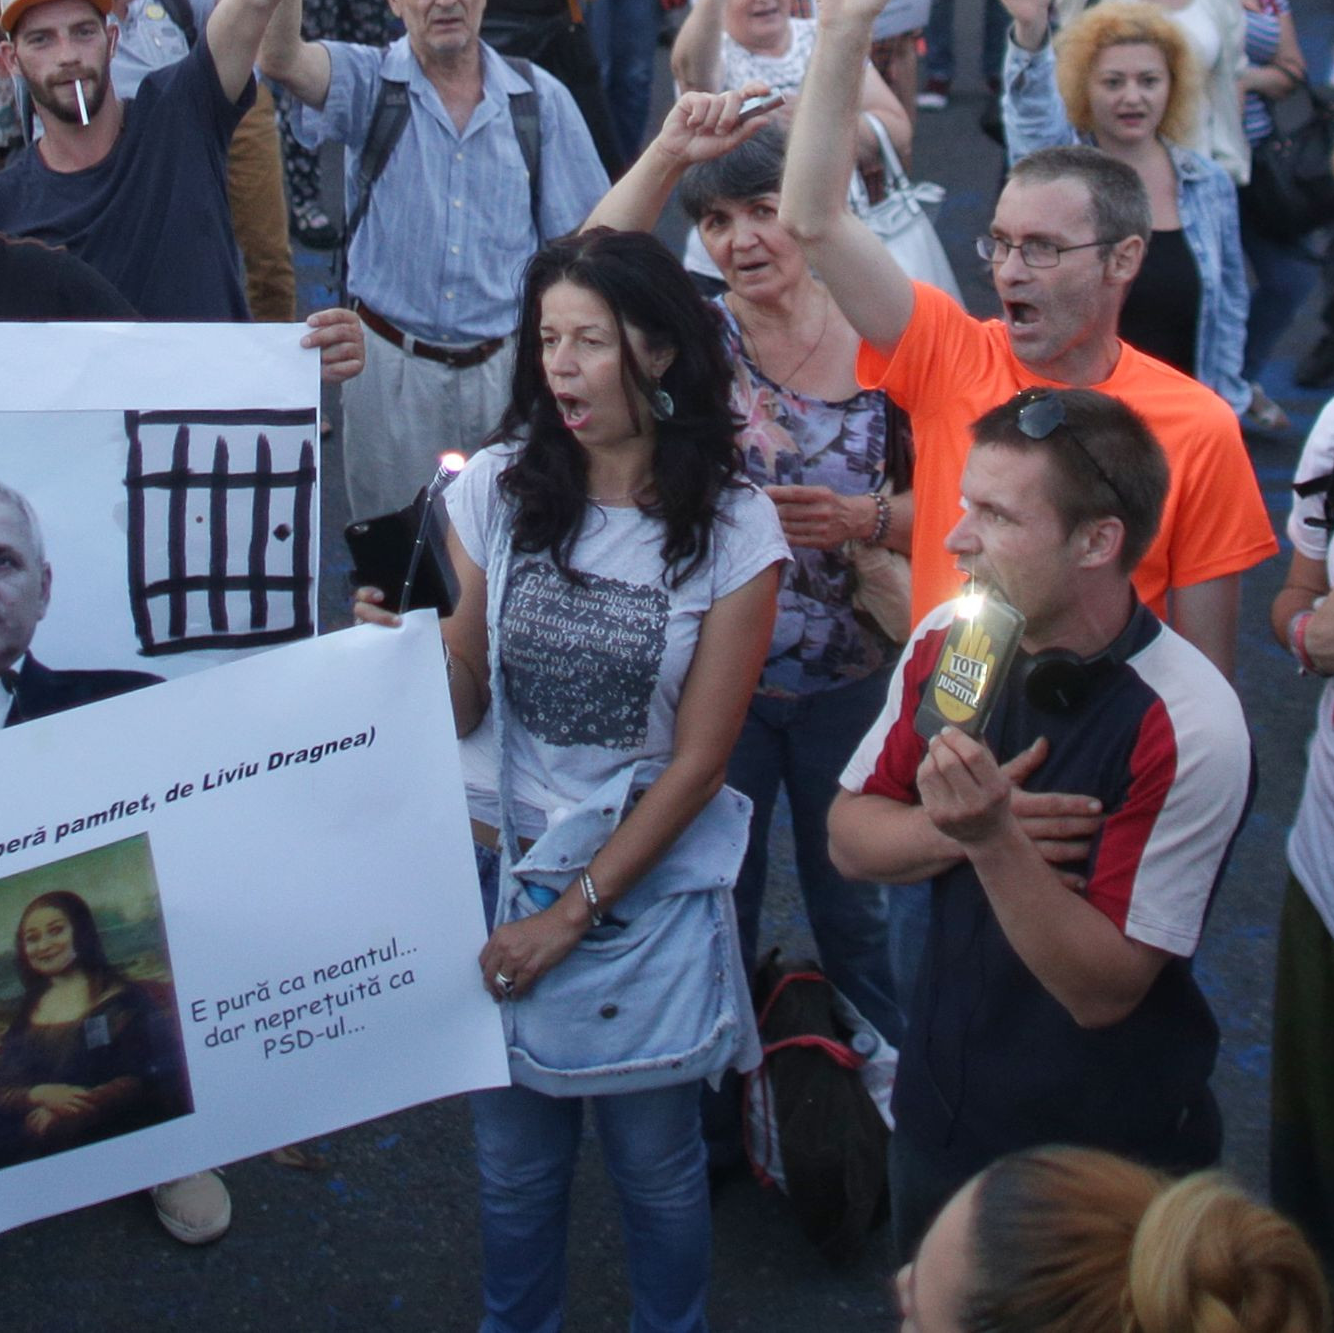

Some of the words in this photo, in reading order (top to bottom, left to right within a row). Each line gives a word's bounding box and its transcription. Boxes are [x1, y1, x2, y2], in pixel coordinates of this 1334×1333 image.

[519, 608, 589, 633] continue
[608, 629, 649, 645] sleep
[573, 596, 600, 611] two
[54, 793, 156, 844] pamflet,
[164, 781, 194, 804] de
[202, 761, 260, 792] Liviu
[266, 725, 376, 771] Dragnea)
[190, 999, 208, 1023] E
[216, 980, 271, 1021] pură
[279, 975, 306, 995] ca
[313, 937, 417, 985] neantul...
[204, 1023, 245, 1048] dar
[254, 974, 381, 1033] neprețuită
[389, 969, 415, 990] ca
[263, 1015, 366, 1059] PSD-ul...
